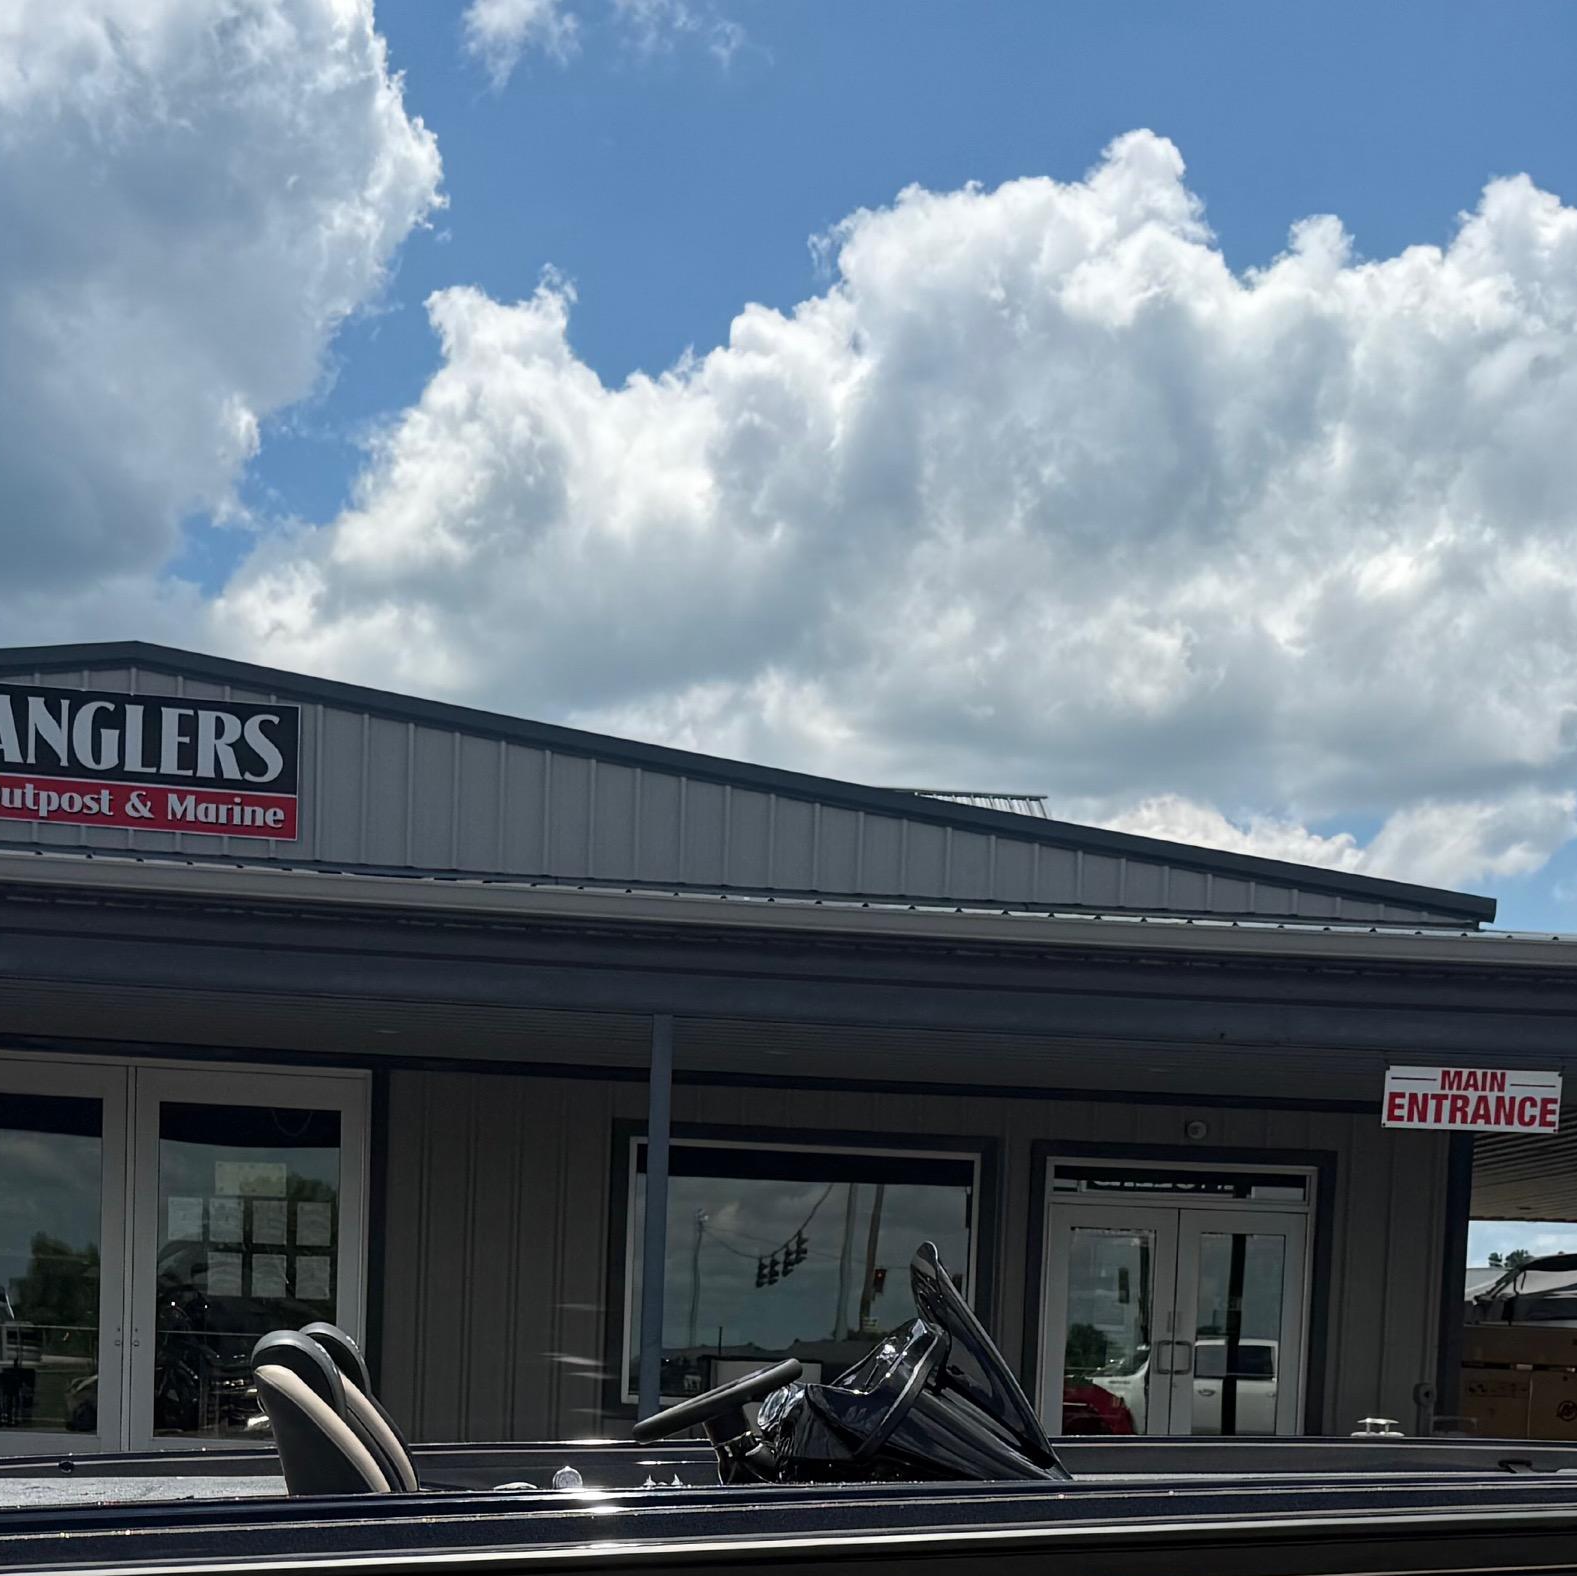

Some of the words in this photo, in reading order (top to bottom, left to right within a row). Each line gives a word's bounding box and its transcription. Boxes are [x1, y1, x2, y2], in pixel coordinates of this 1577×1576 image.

[125, 791, 155, 819] &
[167, 793, 285, 828] Marine
[1440, 1070, 1507, 1093] MAIN
[1386, 1091, 1559, 1128] ENTRANCE
